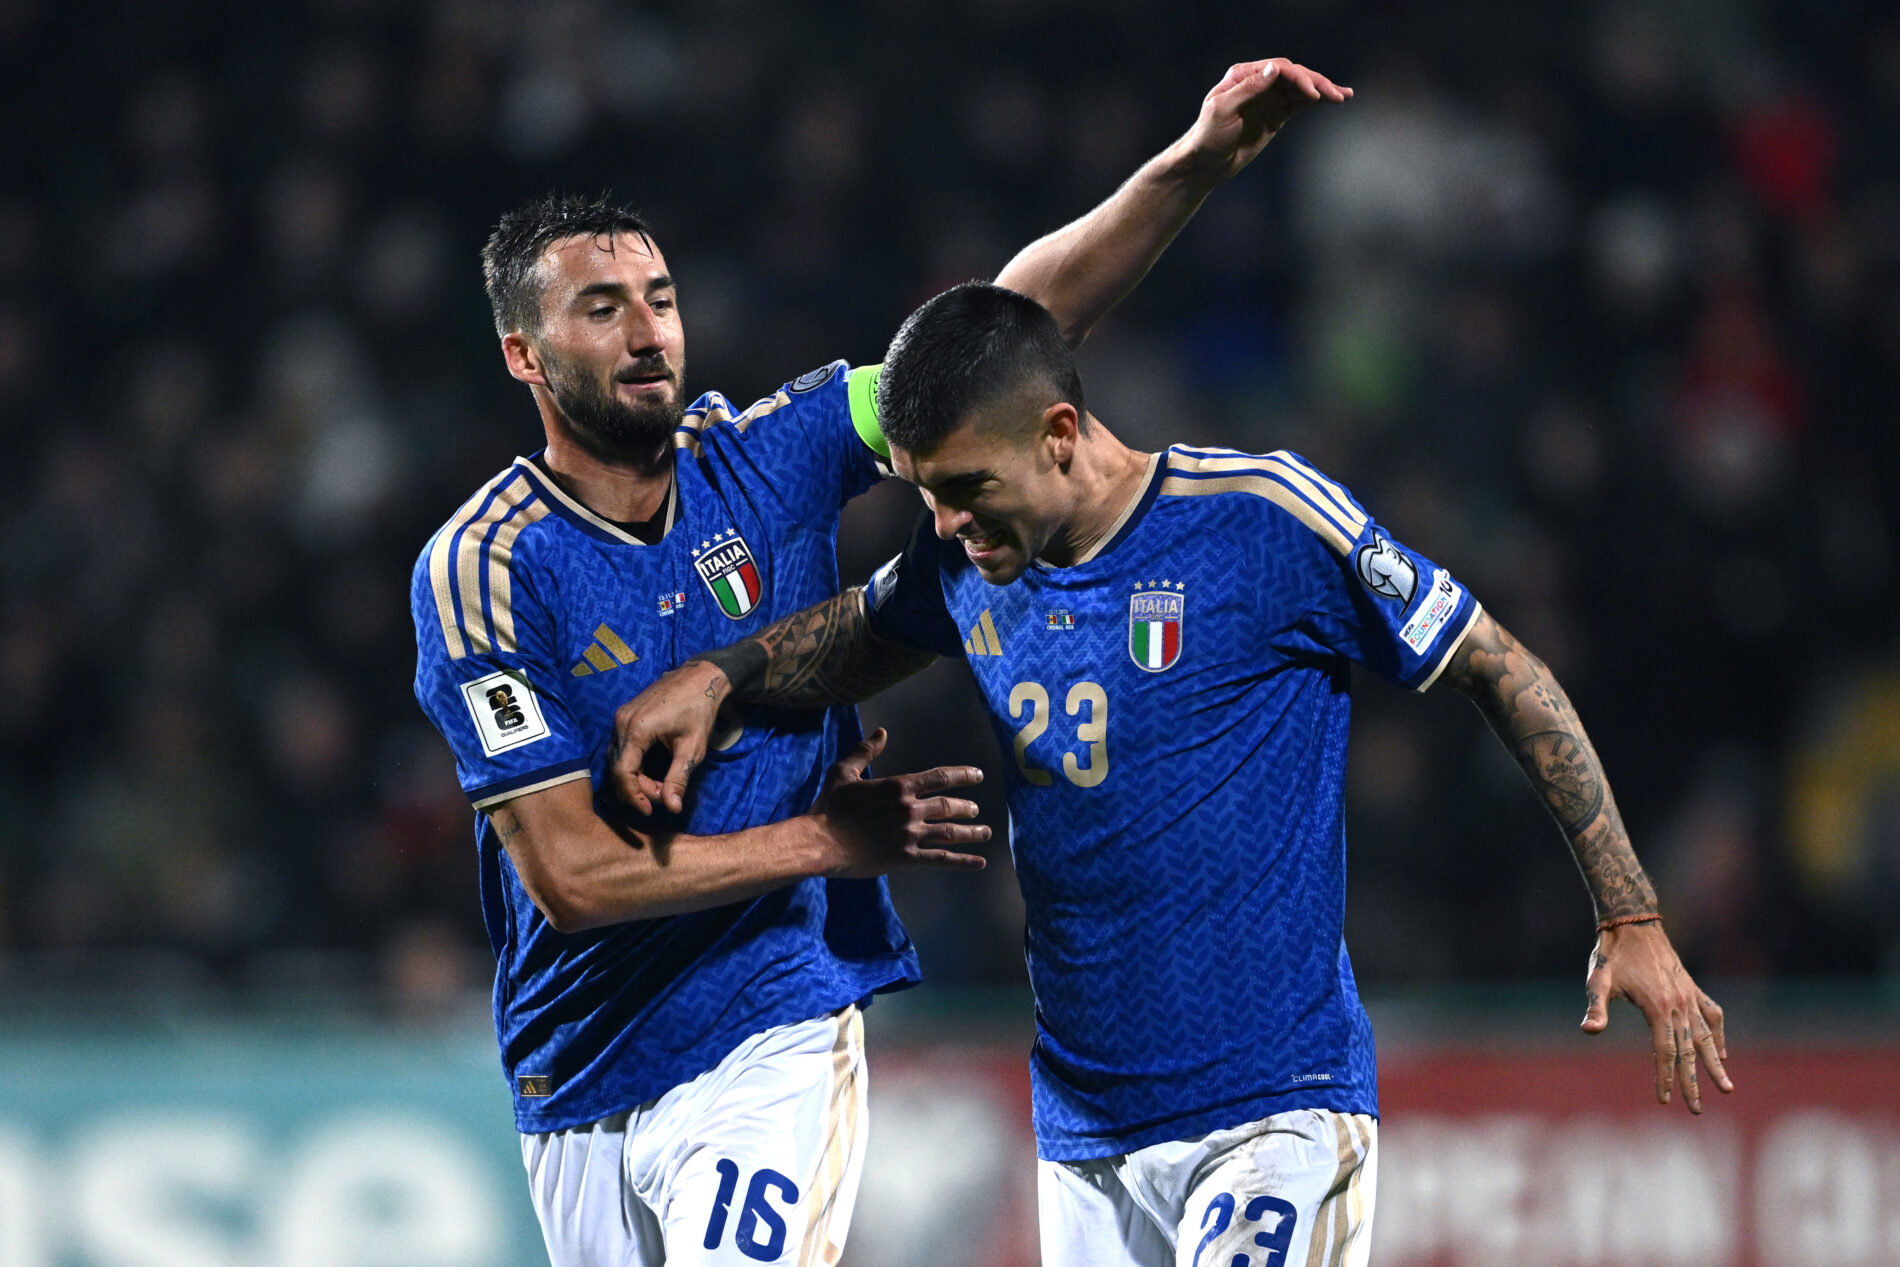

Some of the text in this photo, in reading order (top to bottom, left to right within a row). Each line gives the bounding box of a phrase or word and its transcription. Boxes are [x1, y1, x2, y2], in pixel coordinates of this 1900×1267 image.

[700, 545, 746, 577] ITALIA
[1135, 599, 1178, 613] ITALIA
[1409, 597, 1446, 646] FOUNDATION
[505, 717, 518, 726] FIFA
[1008, 681, 1109, 788] 23
[703, 1158, 799, 1262] 16
[1192, 1192, 1297, 1267] 23
